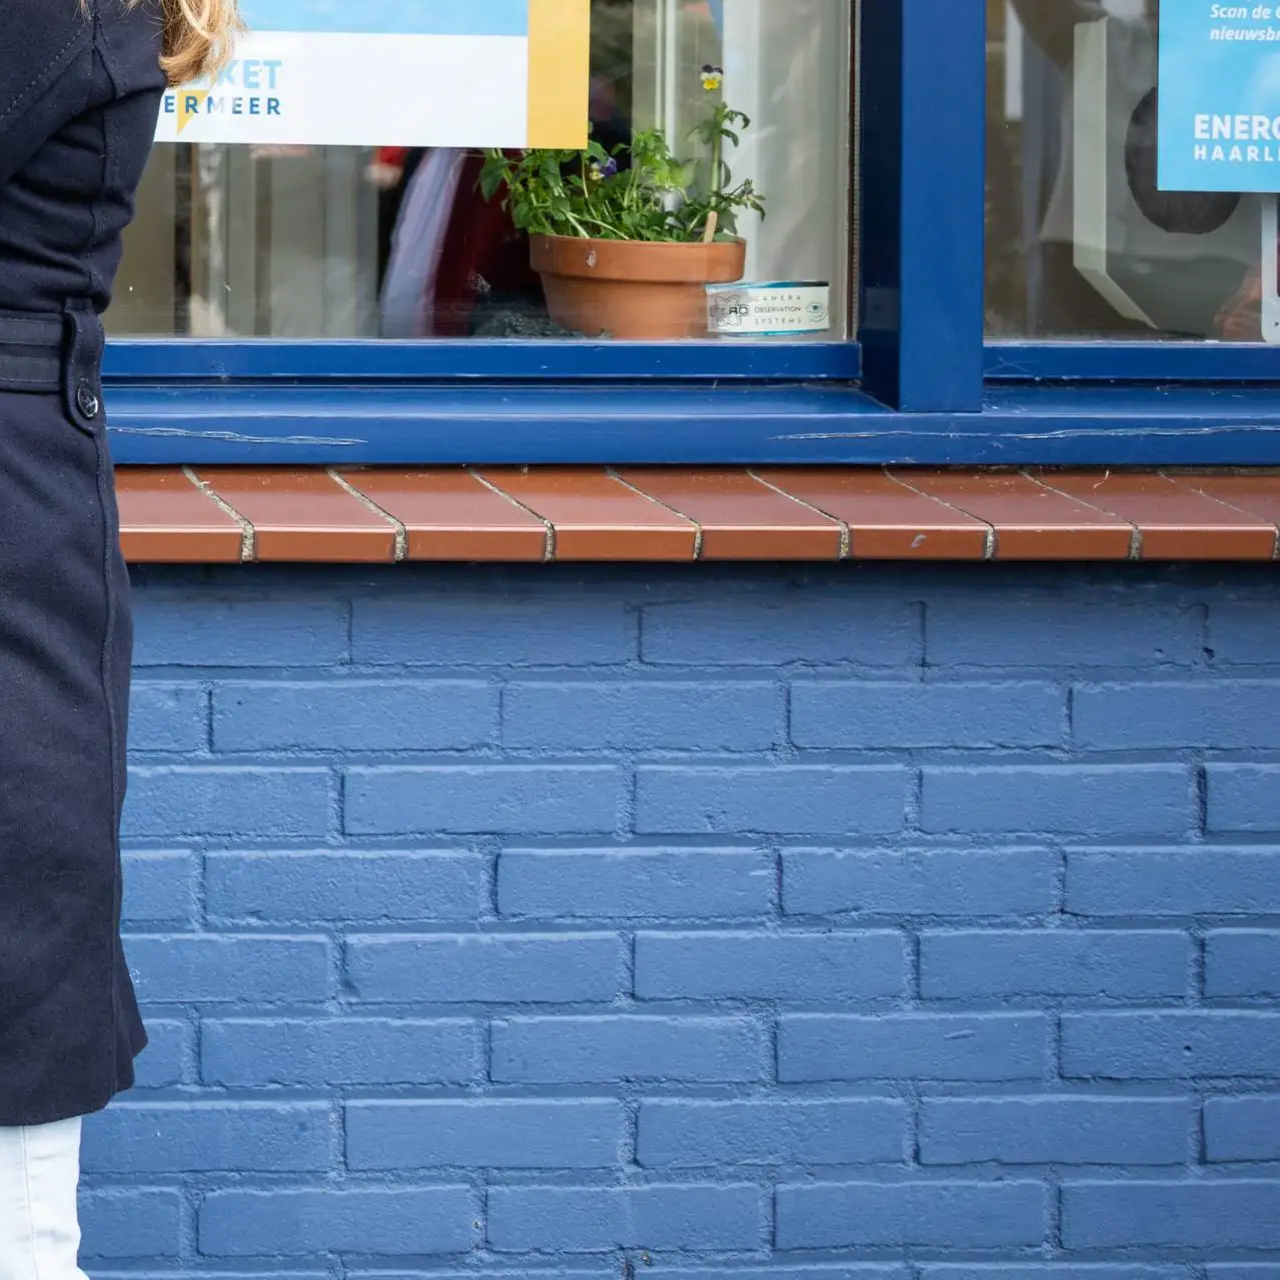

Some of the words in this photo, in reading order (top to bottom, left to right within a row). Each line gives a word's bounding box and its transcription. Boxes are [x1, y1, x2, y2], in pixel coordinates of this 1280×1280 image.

[1209, 4, 1249, 19] Scan
[1252, 4, 1272, 19] de
[1194, 143, 1280, 162] HAARL
